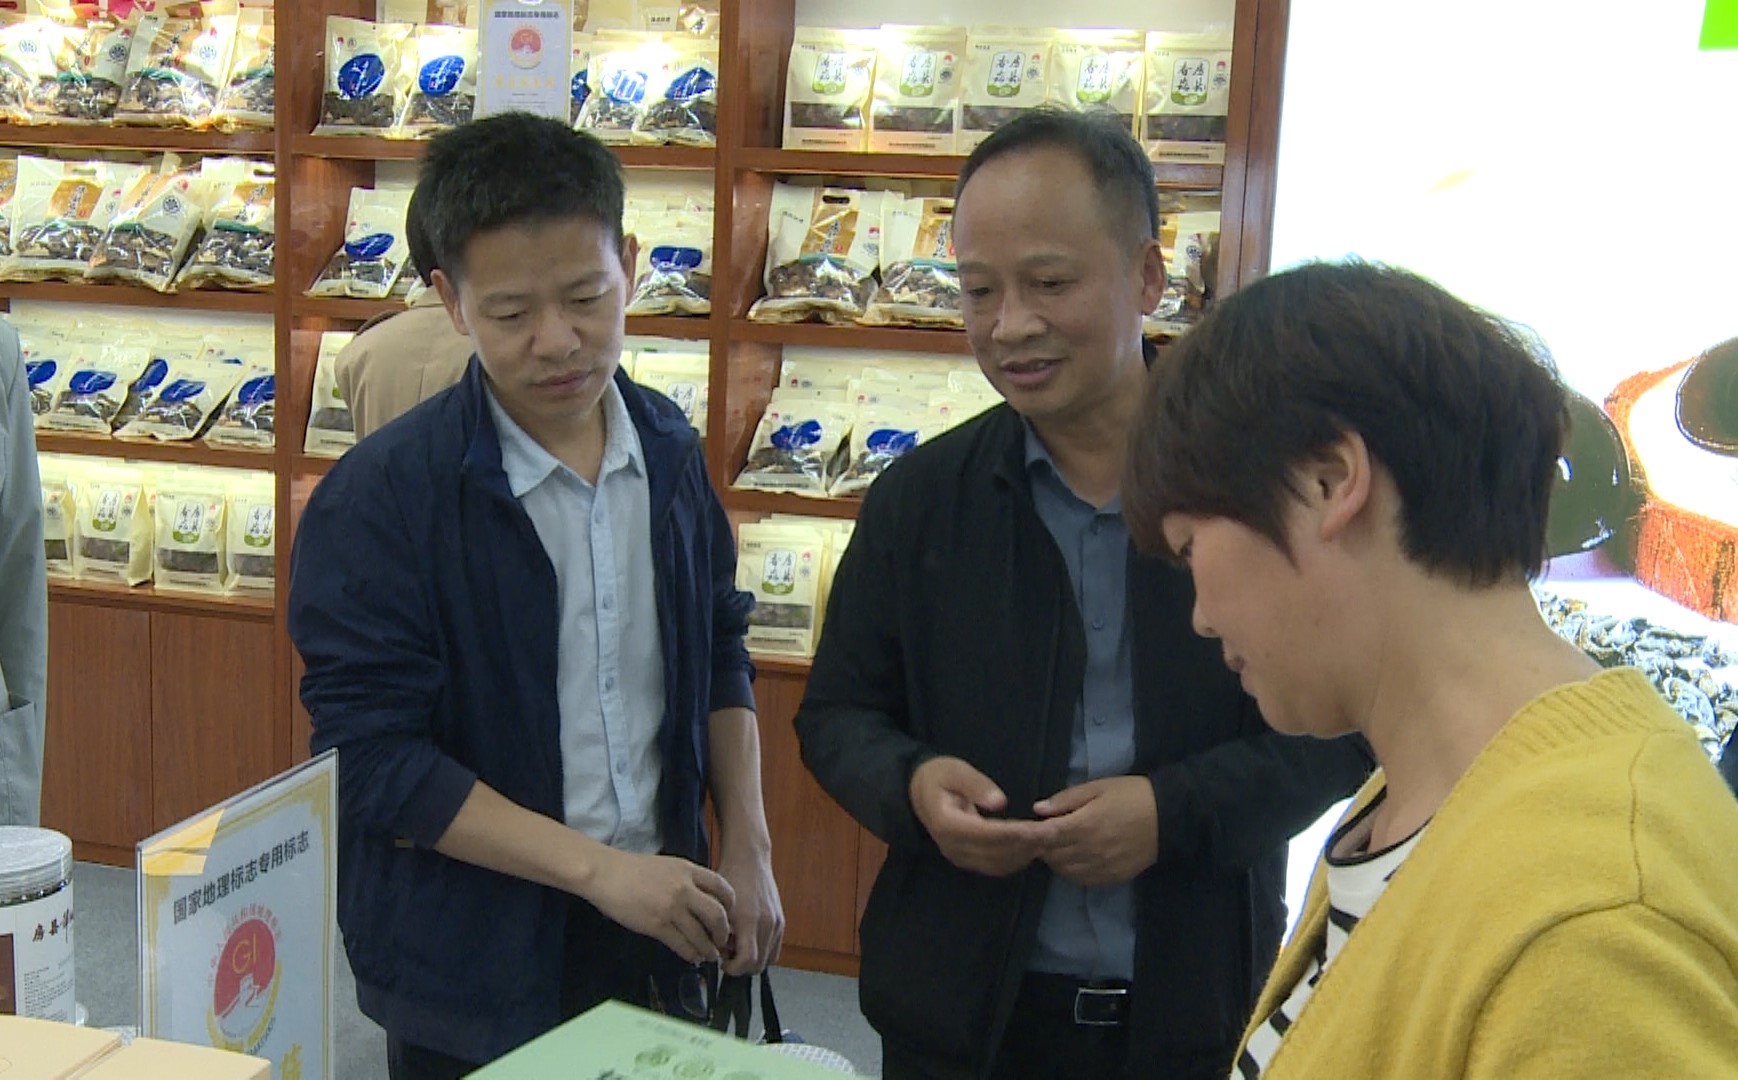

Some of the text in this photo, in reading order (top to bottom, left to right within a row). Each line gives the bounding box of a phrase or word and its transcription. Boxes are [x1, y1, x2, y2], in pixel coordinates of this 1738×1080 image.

[174, 830, 310, 925] 国家地理标志专用标志
